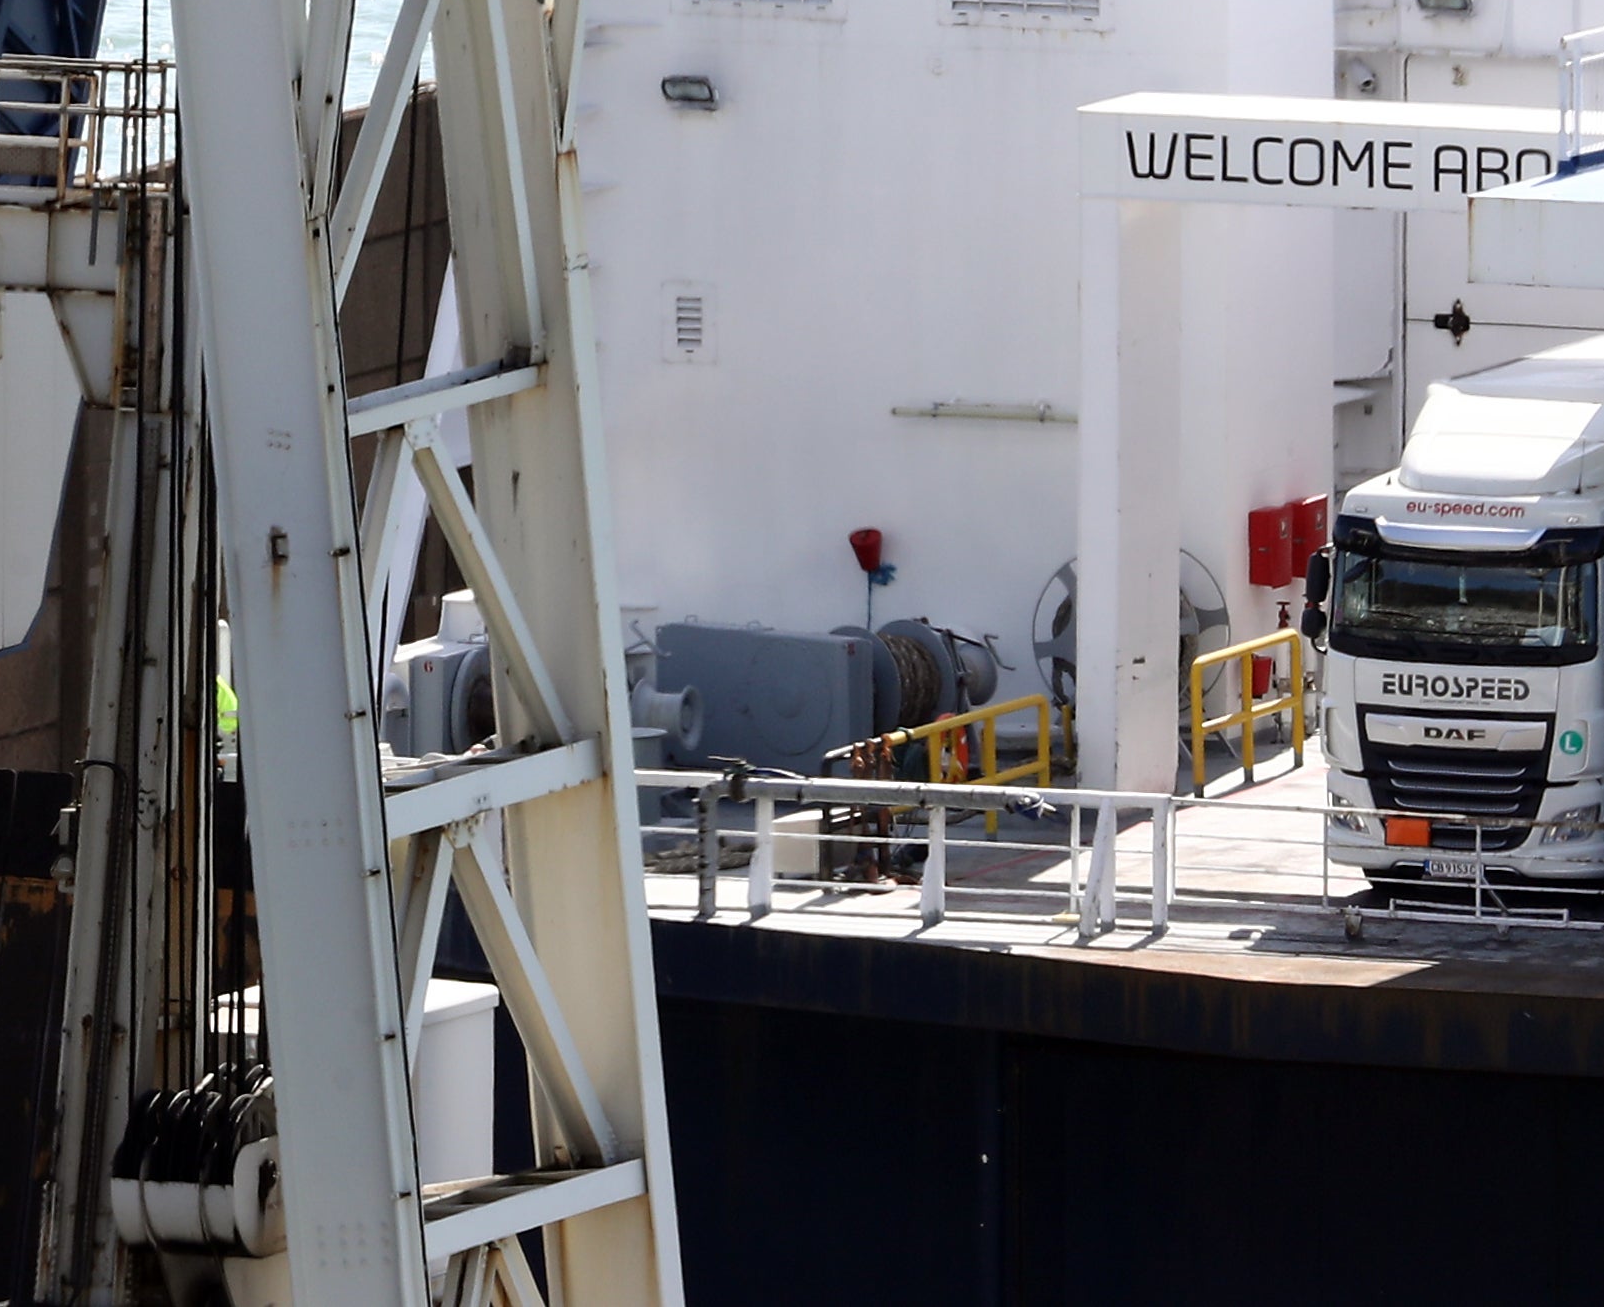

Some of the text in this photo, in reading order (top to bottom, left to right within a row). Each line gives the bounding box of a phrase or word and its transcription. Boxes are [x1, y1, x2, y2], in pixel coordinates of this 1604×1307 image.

[1125, 129, 1552, 194] WELCOME ABO
[1406, 500, 1526, 519] eu-speed.com
[1382, 673, 1530, 701] EUROSPEED
[1424, 727, 1486, 741] DAF
